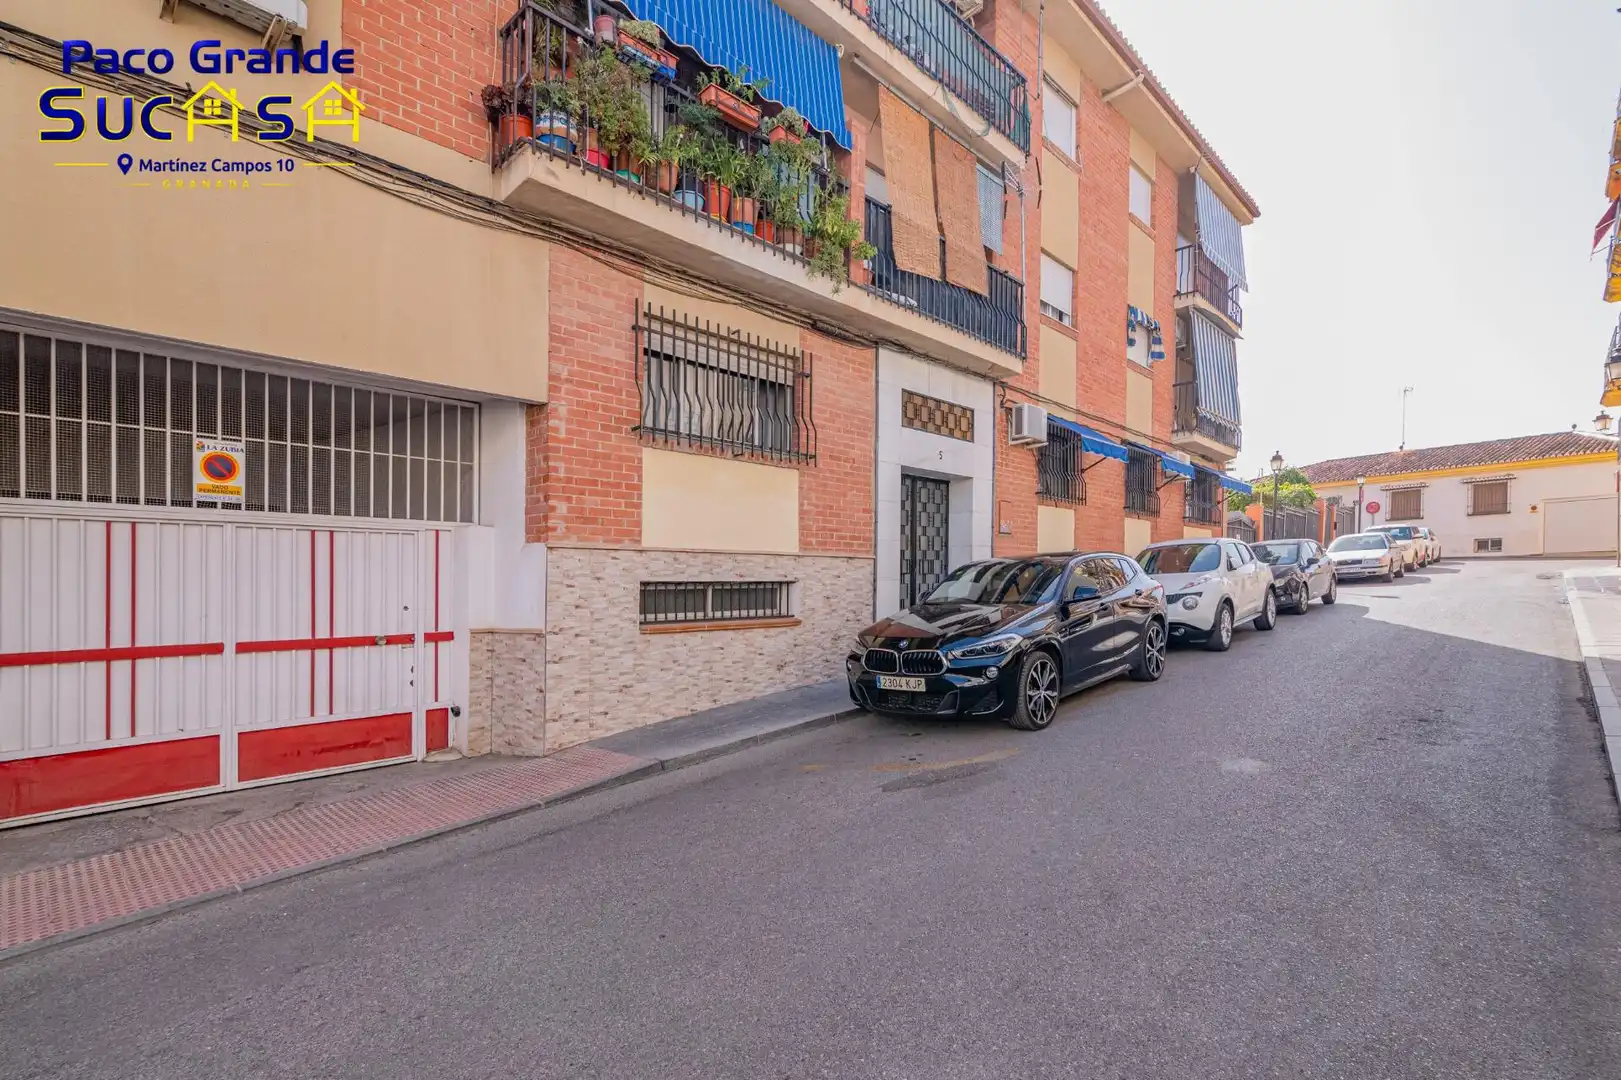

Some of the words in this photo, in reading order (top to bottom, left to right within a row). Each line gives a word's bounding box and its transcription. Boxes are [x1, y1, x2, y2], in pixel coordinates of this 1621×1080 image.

[938, 450, 943, 460] 5
[198, 487, 241, 496] PERMANENTE
[882, 677, 903, 689] 2304
[905, 678, 923, 690] KJP
